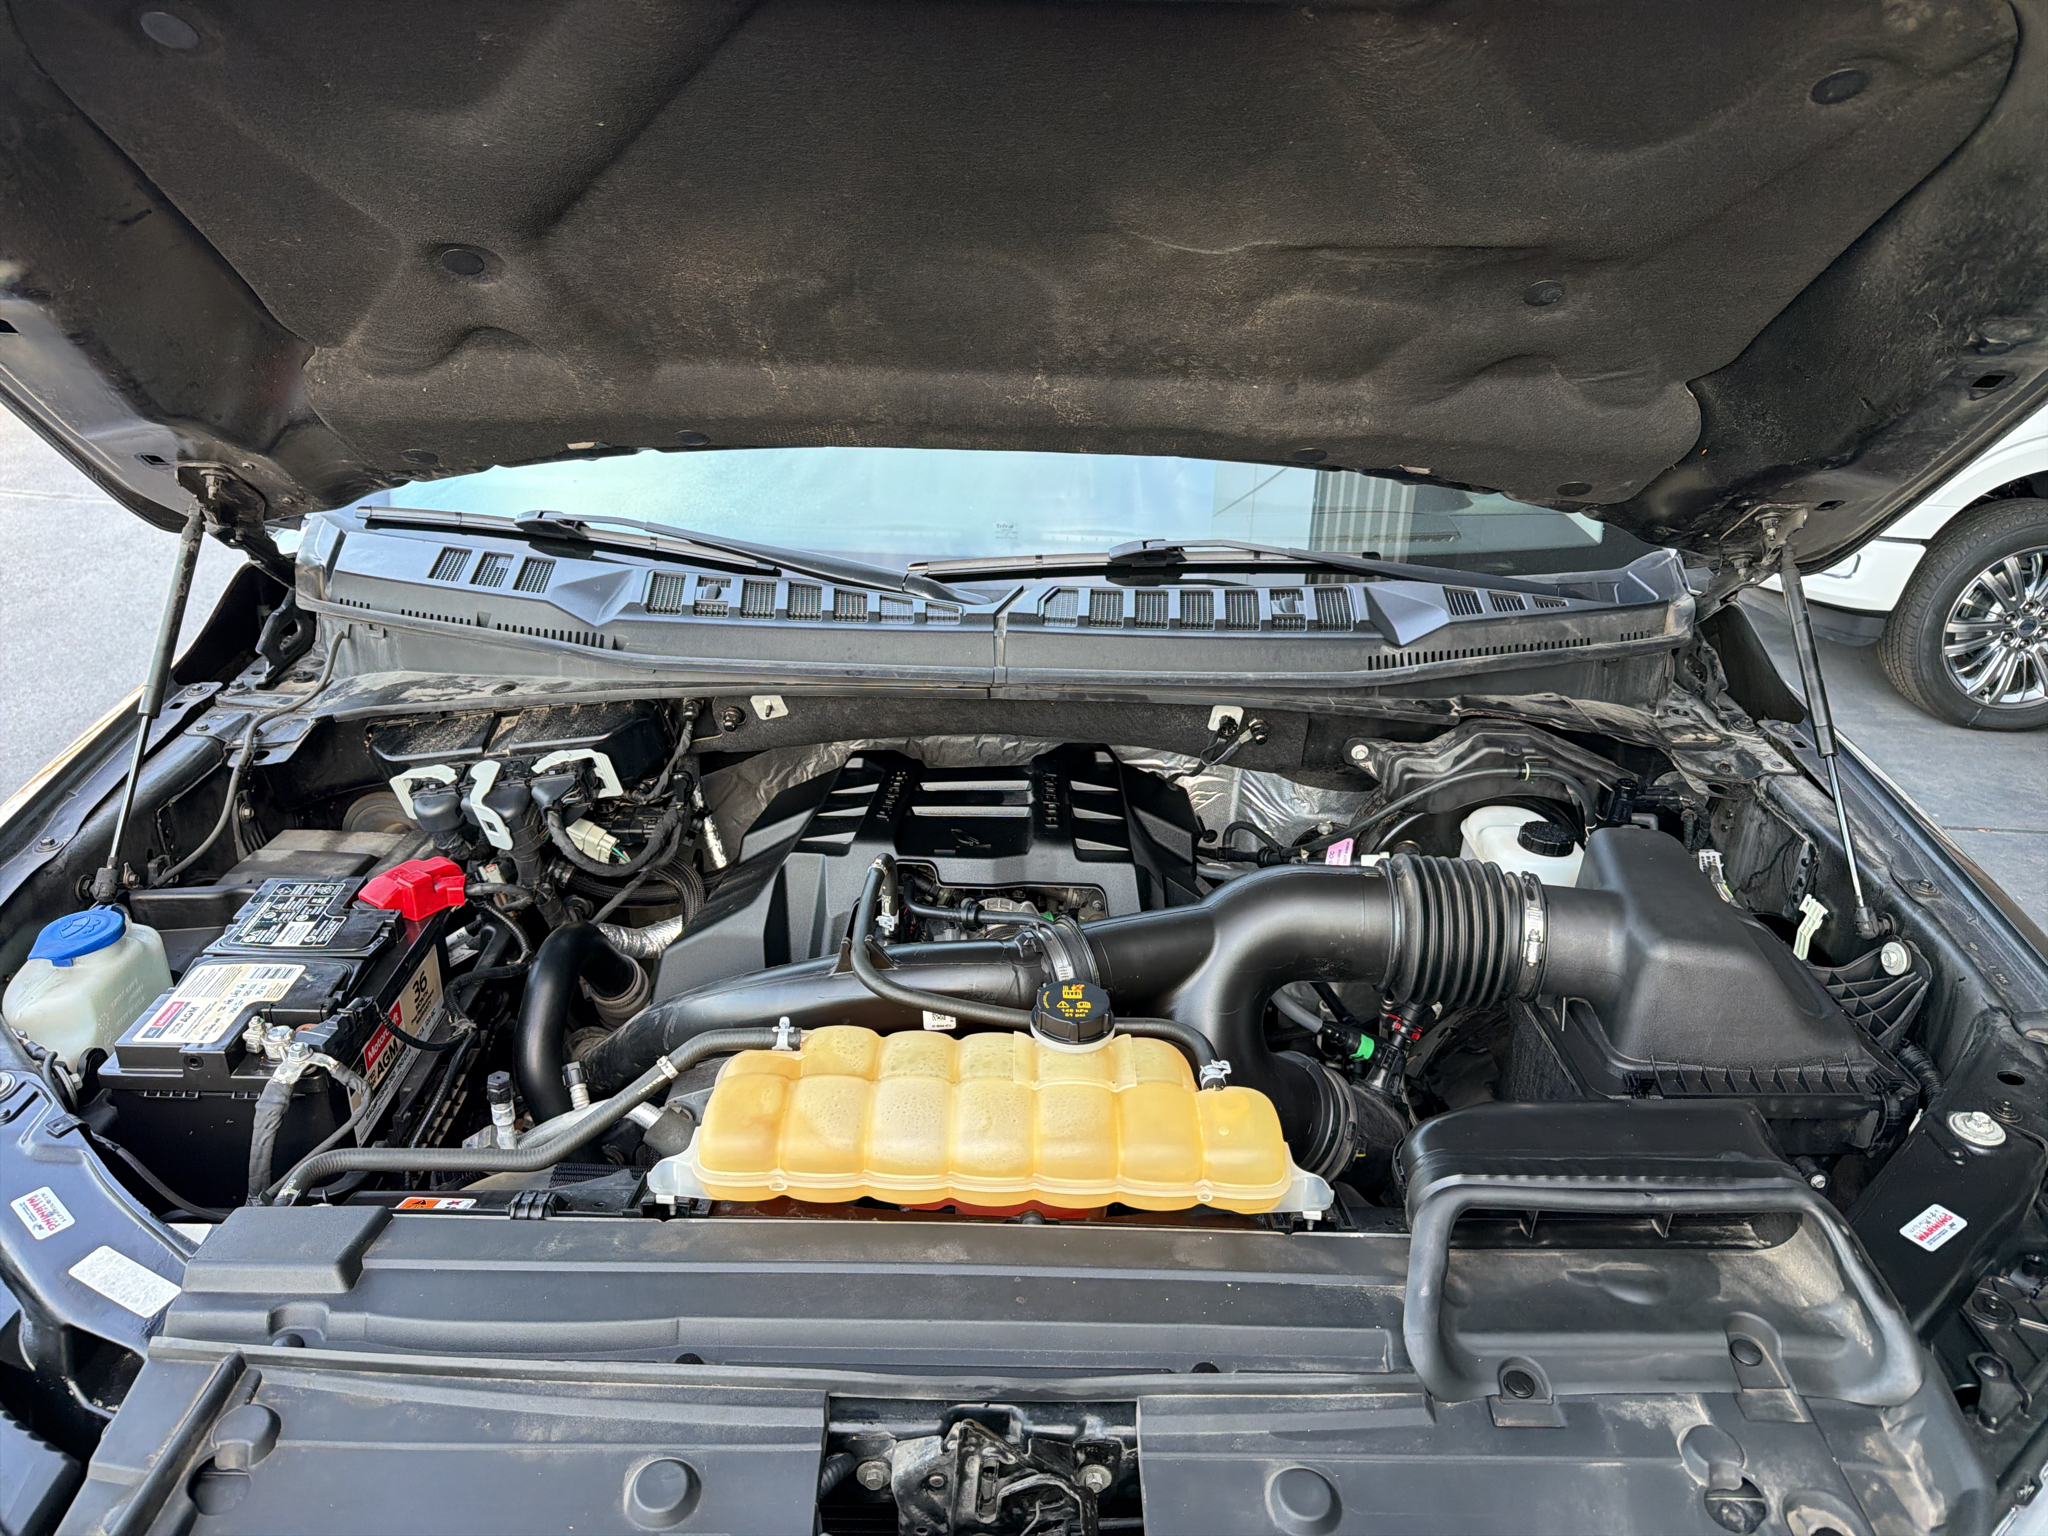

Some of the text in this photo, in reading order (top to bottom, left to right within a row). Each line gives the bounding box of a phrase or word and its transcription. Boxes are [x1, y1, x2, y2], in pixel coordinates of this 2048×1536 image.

[412, 970, 428, 1004] 36
[367, 1011, 399, 1062] Motorcft
[377, 1037, 399, 1079] AGM
[26, 1196, 57, 1231] WARNING
[1917, 1214, 1953, 1242] WARNING
